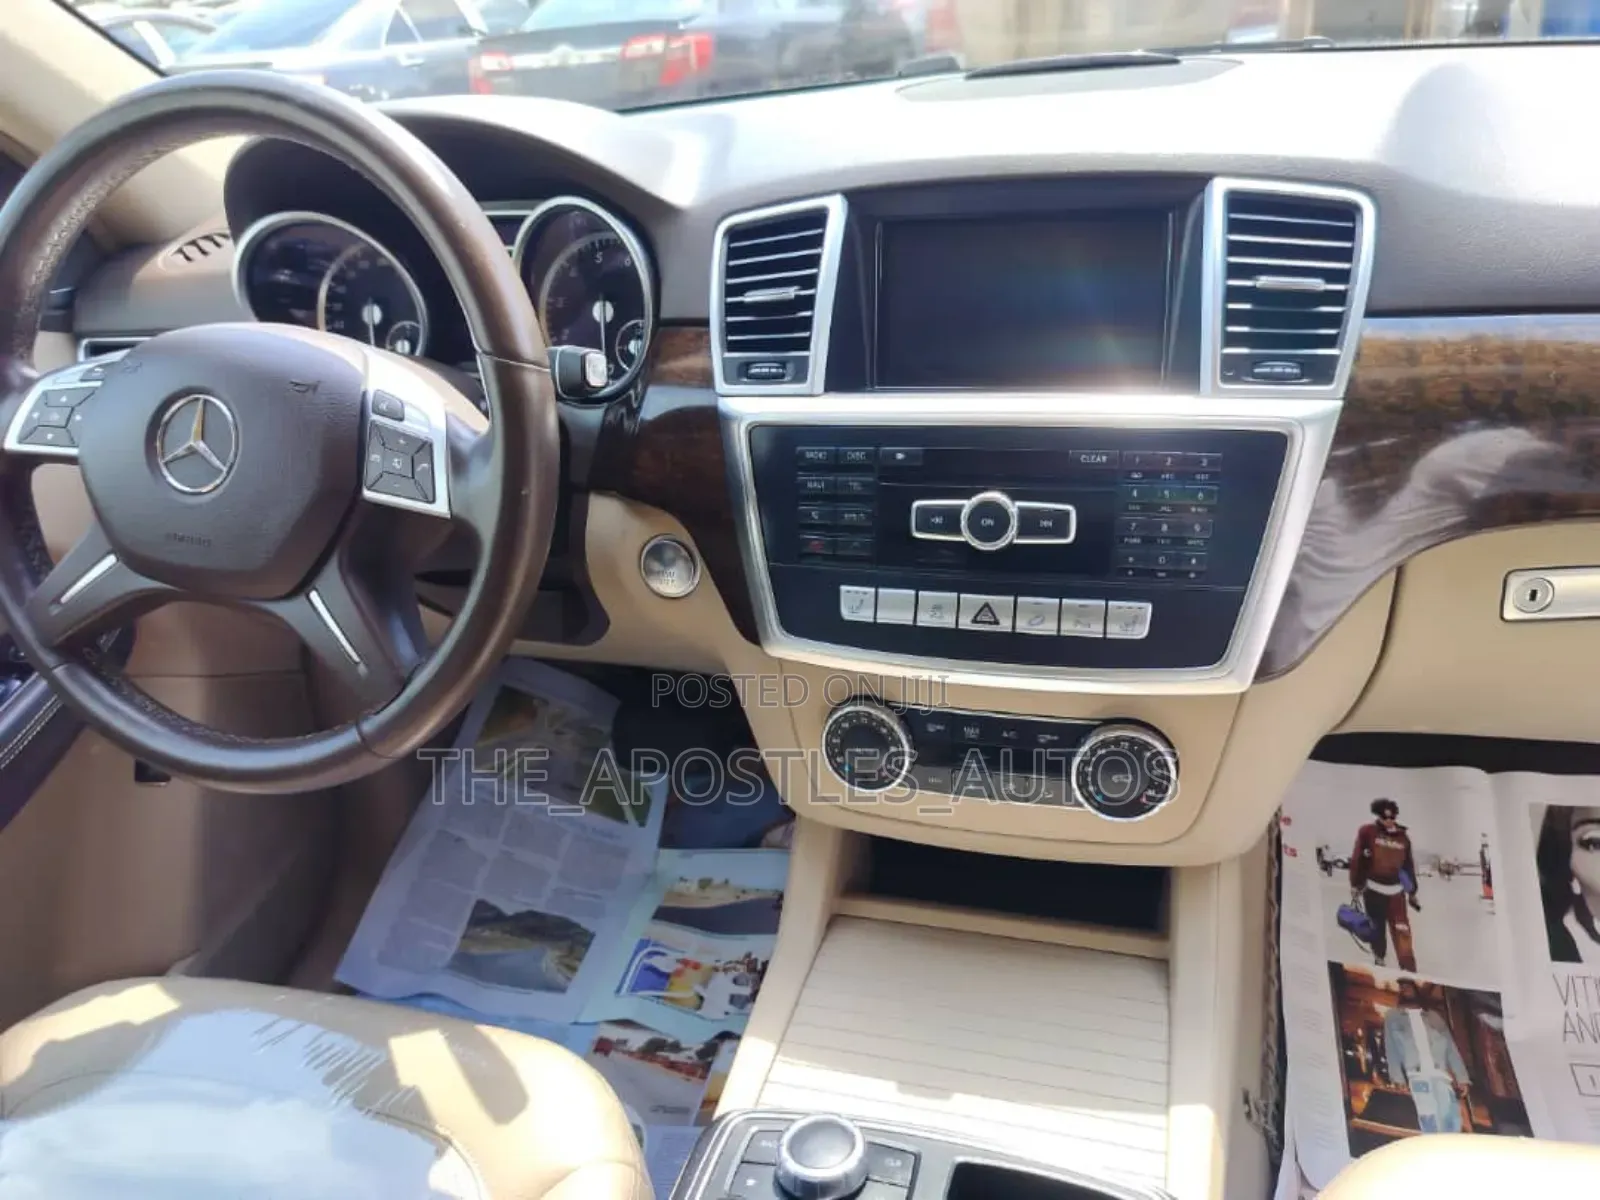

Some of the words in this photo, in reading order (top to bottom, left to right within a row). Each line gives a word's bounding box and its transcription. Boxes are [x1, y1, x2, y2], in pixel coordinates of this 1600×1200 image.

[1080, 454, 1107, 463] CLEAR
[1166, 456, 1173, 466] 2
[1201, 458, 1208, 467] 3
[1132, 488, 1139, 498] 4
[981, 518, 995, 526] ON
